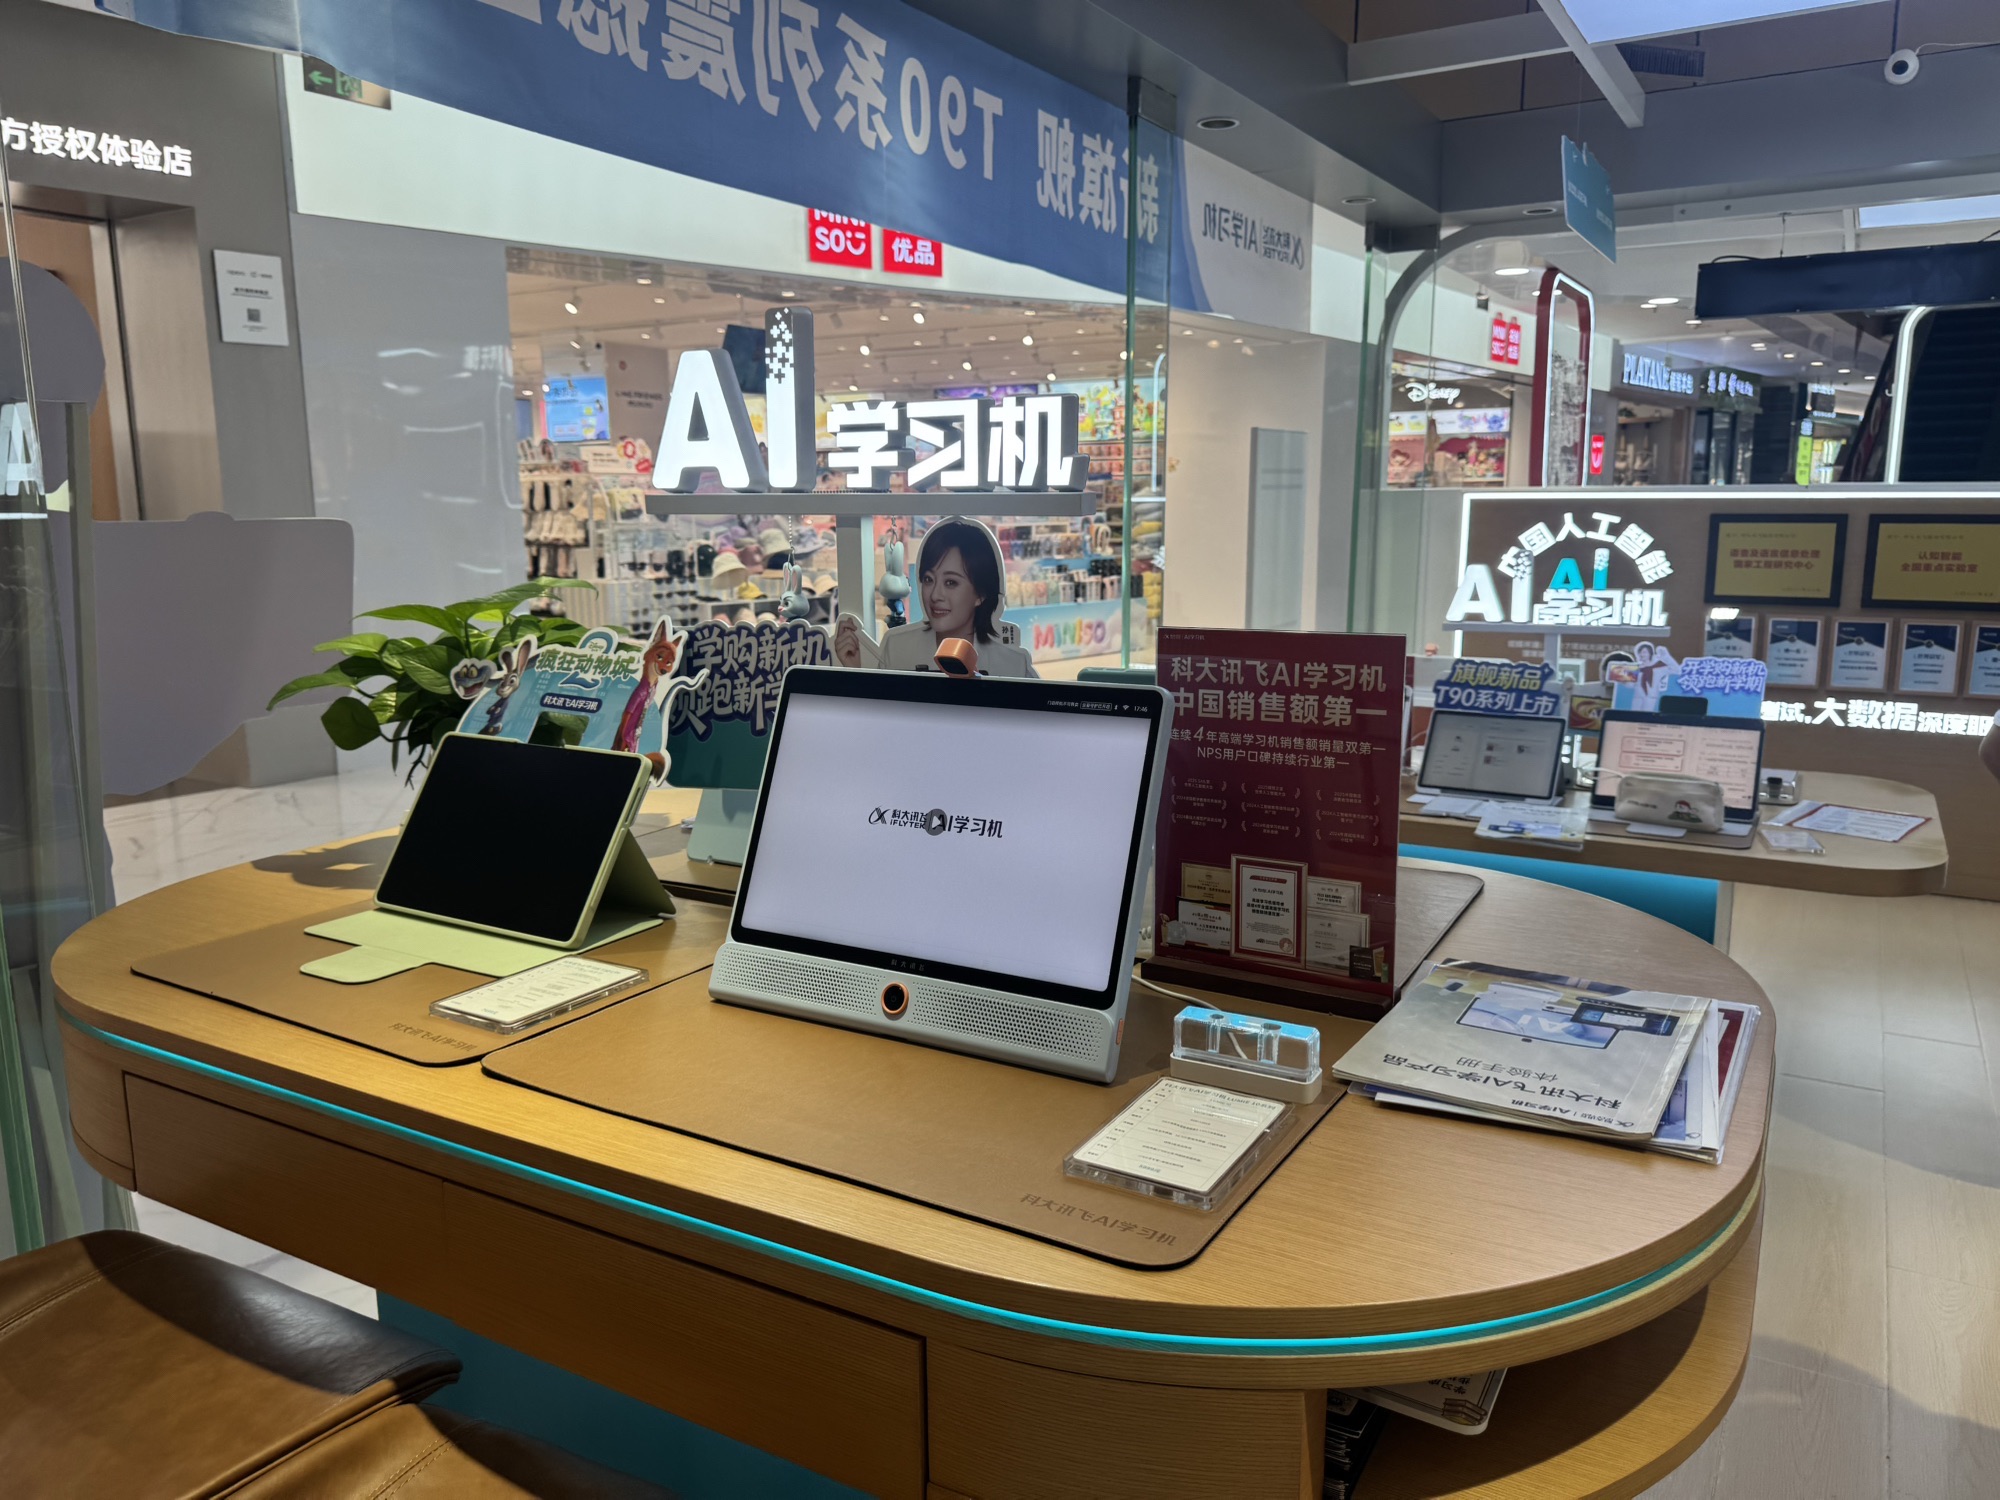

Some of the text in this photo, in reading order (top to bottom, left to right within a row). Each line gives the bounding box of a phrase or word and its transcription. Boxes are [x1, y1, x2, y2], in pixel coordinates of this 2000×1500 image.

[1, 117, 192, 177] 方授权体验店
[892, 237, 935, 266] 优品
[652, 306, 1082, 490] AI学习机
[535, 649, 640, 681] 疯狂动物城
[680, 626, 831, 676] 学购新机
[1170, 656, 1388, 693] 科大讯飞AI学习机
[1451, 663, 1542, 691] 旗舰新品
[1677, 674, 1763, 694] 领跑新学期
[1682, 660, 1766, 677] 开学购新机
[543, 695, 599, 711] 科大讯飞AI学习机
[1172, 686, 1388, 727] 中国销售额第一
[1436, 685, 1557, 716] T90系列上市
[1197, 746, 1350, 770] NPS用户口碑持续行业第一
[891, 809, 928, 822] 科大讯飞
[1383, 1053, 1622, 1110] 科大讯飞AI学习产品
[1455, 1056, 1559, 1083] 体验手册
[1019, 1193, 1178, 1247] 科大讯飞AI学习机
